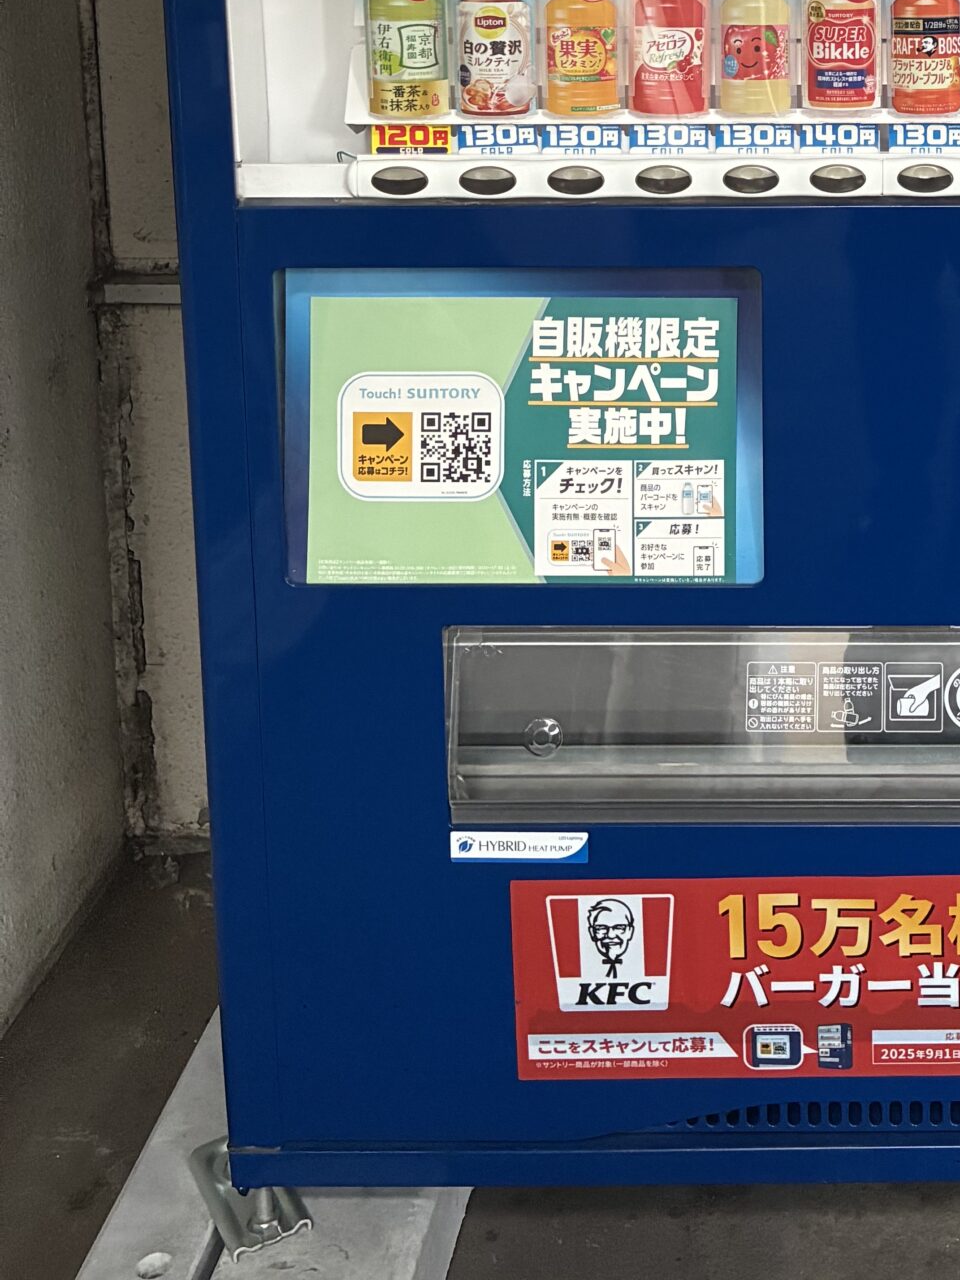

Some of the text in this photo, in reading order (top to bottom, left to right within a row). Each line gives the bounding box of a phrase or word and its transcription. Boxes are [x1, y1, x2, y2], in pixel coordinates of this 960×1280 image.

[476, 18, 504, 28] Lipton
[814, 25, 866, 42] SUPER
[377, 23, 393, 76] 伊右衛門
[418, 33, 433, 59] 京都
[463, 39, 522, 56] 白の贅沢
[559, 40, 598, 58] 果実
[647, 37, 687, 53] アセロラ
[813, 41, 869, 59] Bikkle
[892, 37, 920, 55] CRAFT
[466, 57, 519, 67] ミルクティー
[374, 125, 449, 144] 120円
[459, 125, 536, 144] 130円
[543, 125, 619, 145] 130円
[633, 125, 706, 145] 130円
[719, 125, 792, 145] 130円
[802, 125, 875, 145] 140円
[531, 316, 720, 358] 自販機限定
[529, 362, 719, 402] キャンペーン
[359, 388, 481, 399] Touch! SUNTORY
[568, 407, 688, 445] 実施中!
[358, 454, 408, 465] キャンペーン
[358, 466, 408, 476] 応募はコチラ!
[567, 466, 623, 475] キャンペーンを
[652, 464, 718, 475] 買ってスキャン!
[559, 477, 622, 494] チェック!
[669, 523, 699, 535] 応募!
[478, 840, 527, 852] HYBRID
[575, 982, 652, 1005] KFC
[538, 1037, 714, 1054] ここをスキャンして応募!
